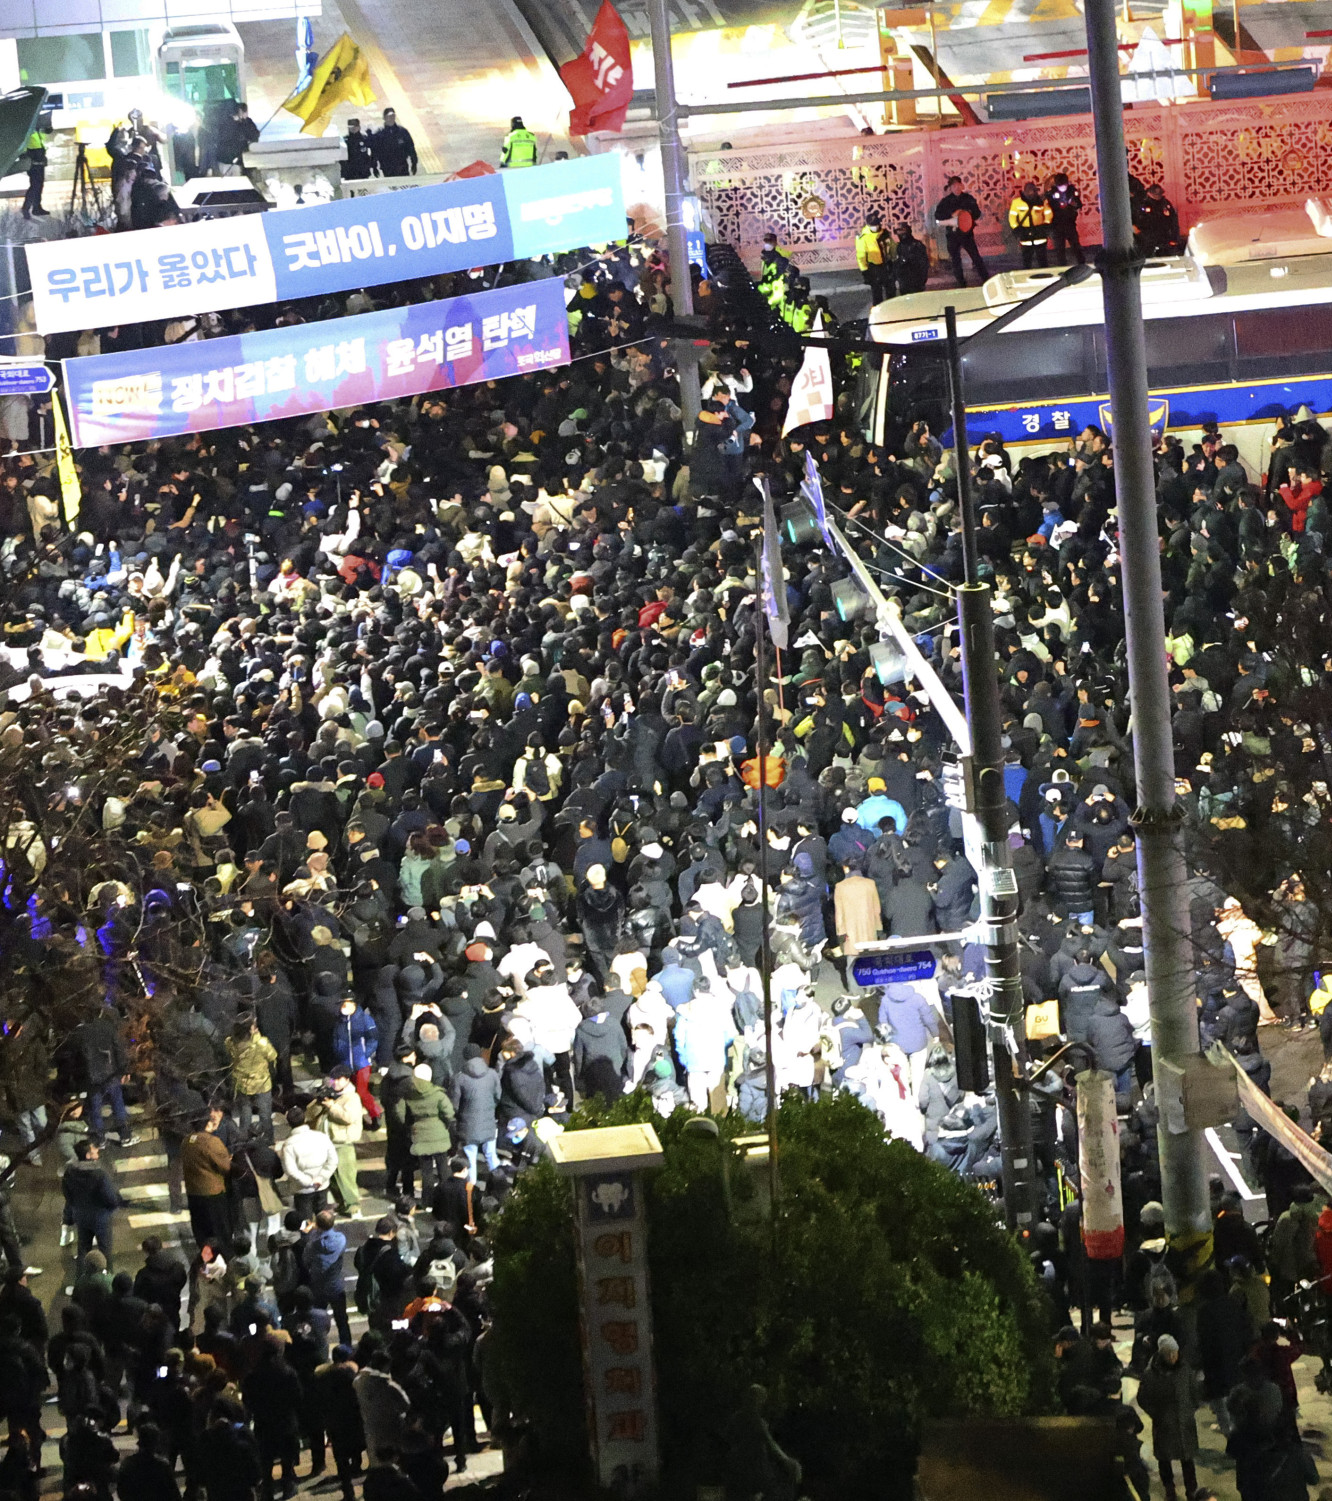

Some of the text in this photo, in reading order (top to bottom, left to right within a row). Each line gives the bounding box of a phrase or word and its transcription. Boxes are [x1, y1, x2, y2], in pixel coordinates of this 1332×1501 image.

[283, 221, 396, 272] 굿바이,
[400, 201, 498, 251] 이재명
[47, 243, 257, 303] 우리가 옳았다
[170, 304, 537, 413] 정치검찰 해체 윤석열 탄핵
[917, 961, 932, 970] 754
